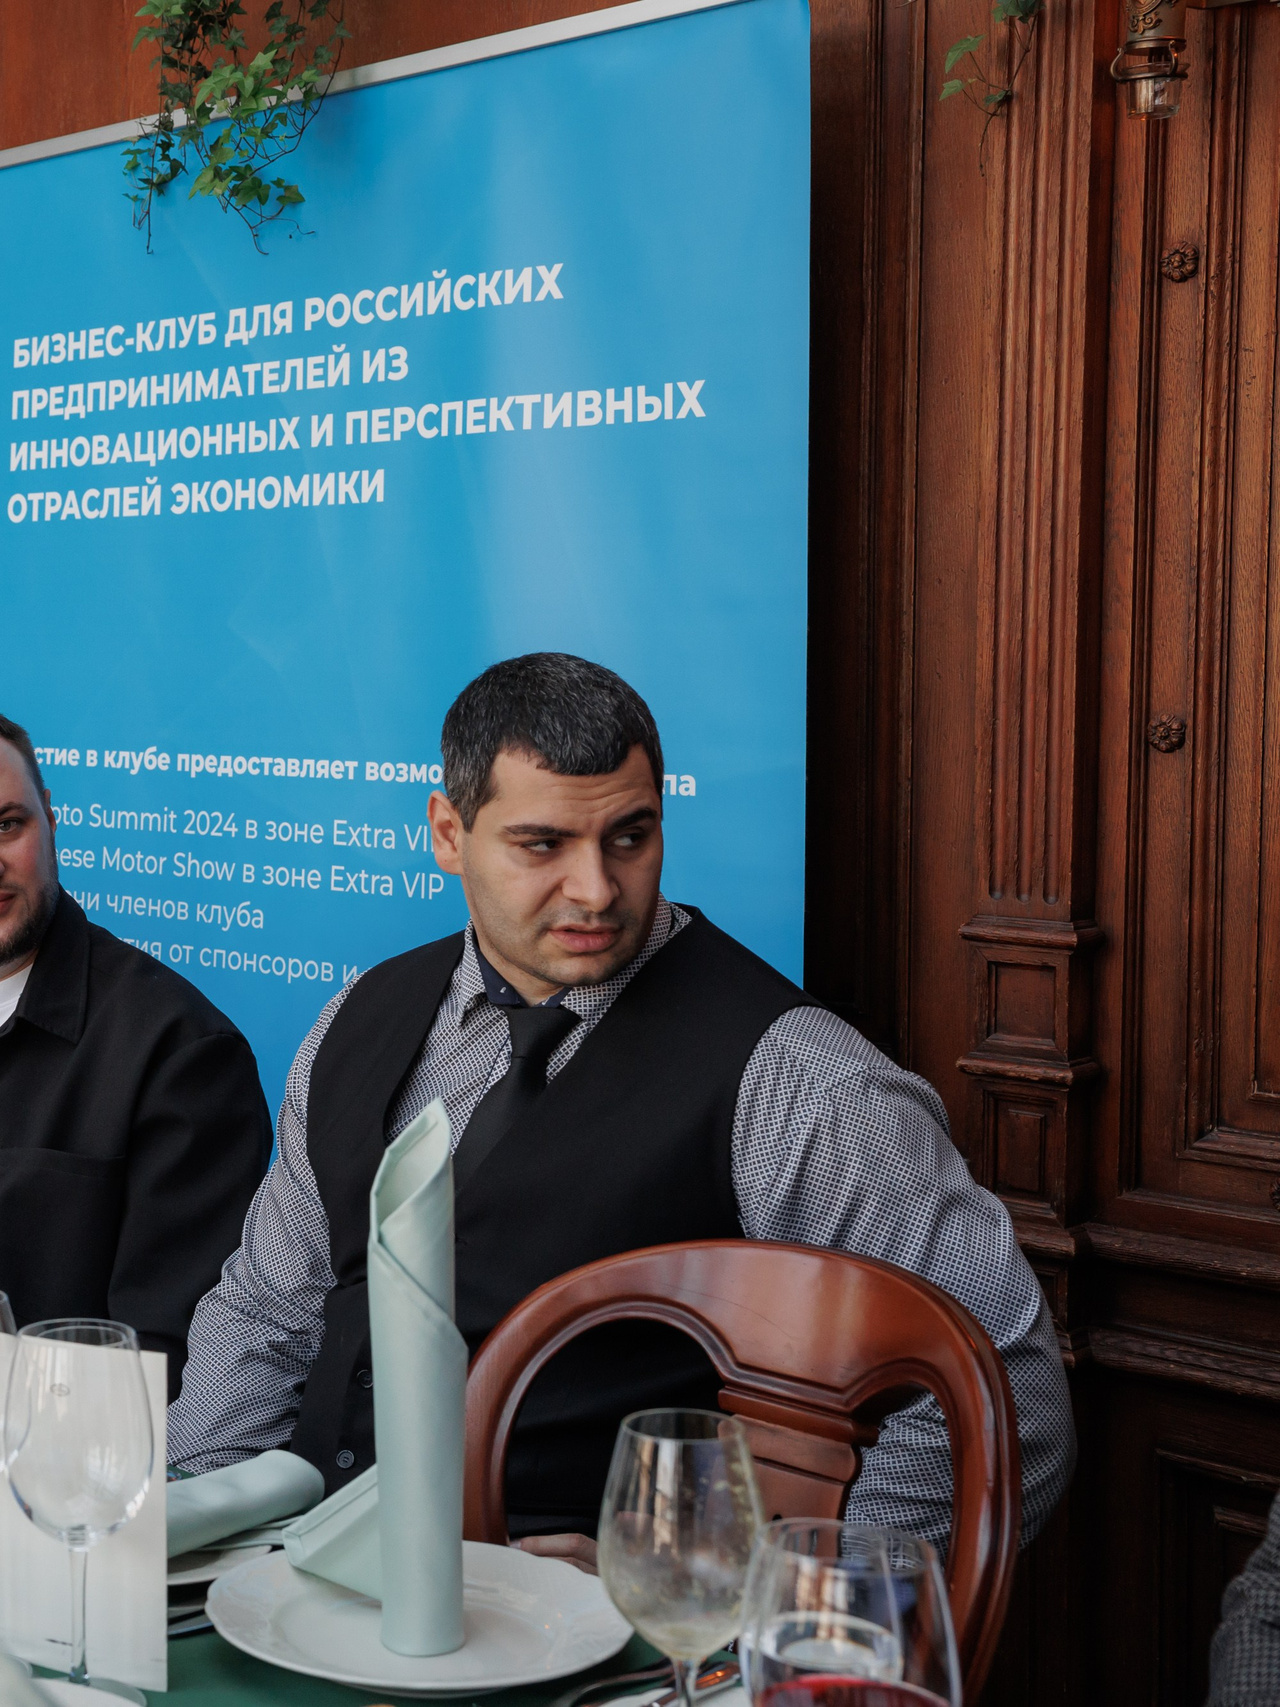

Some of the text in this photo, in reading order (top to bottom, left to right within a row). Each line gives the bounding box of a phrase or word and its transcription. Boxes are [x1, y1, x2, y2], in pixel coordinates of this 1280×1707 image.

[13, 262, 564, 369] БИЗНЕС-КЛУБ ДЛЯ РОССИЙСКИХ
[11, 343, 409, 421] ПРЕДПРИНИМАТЕЛЕЙ ИЗ
[9, 379, 706, 472] ИННОВАЦИОННЫХ И ПЕРСПЕКТИВНЫХ
[7, 468, 385, 524] ОТРАСЛЕЙ ЭКОНОМИКИ
[34, 745, 696, 797] стие в клубе предоставляет возмо па
[89, 803, 177, 834] Summit
[183, 809, 239, 838] 2024
[245, 819, 258, 839] в
[264, 820, 324, 844] зоне
[333, 819, 396, 850] Extra
[403, 824, 434, 852] VI
[56, 846, 445, 900] ese Motor Show в зоне Extra VIP
[65, 889, 265, 932] чи членов клуба
[169, 943, 195, 964] от
[199, 948, 334, 984] спонсоров
